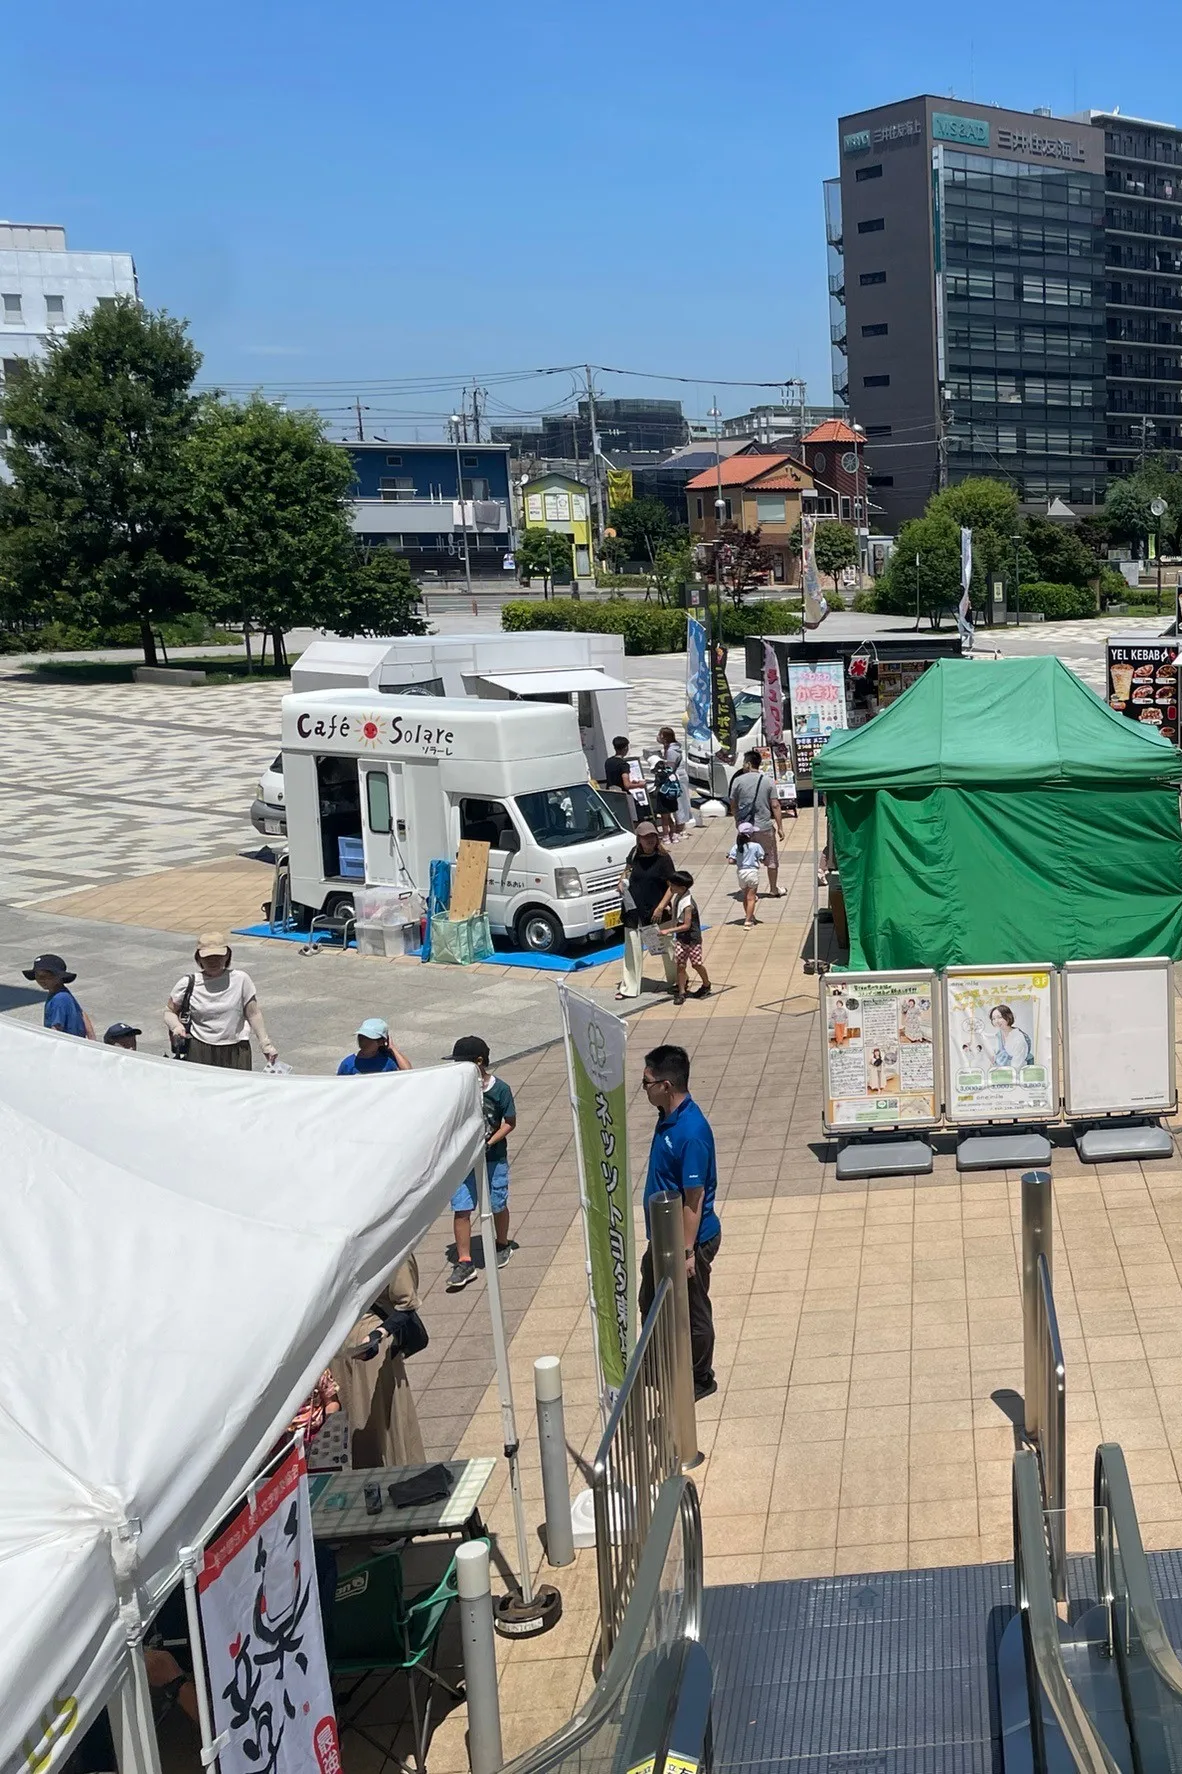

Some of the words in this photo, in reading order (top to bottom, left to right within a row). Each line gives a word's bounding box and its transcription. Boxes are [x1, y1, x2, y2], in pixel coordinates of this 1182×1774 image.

[873, 119, 922, 144] 三井住友海上
[936, 119, 987, 142] MS&AD
[997, 128, 1086, 164] 三井住友海上
[1111, 649, 1129, 660] YEL
[1131, 649, 1161, 661] KEBAB
[795, 684, 839, 702] かき氷
[297, 712, 351, 740] Café
[389, 716, 455, 745] Solare
[422, 746, 454, 757] ソラーレ
[485, 878, 526, 889] ポートあおい
